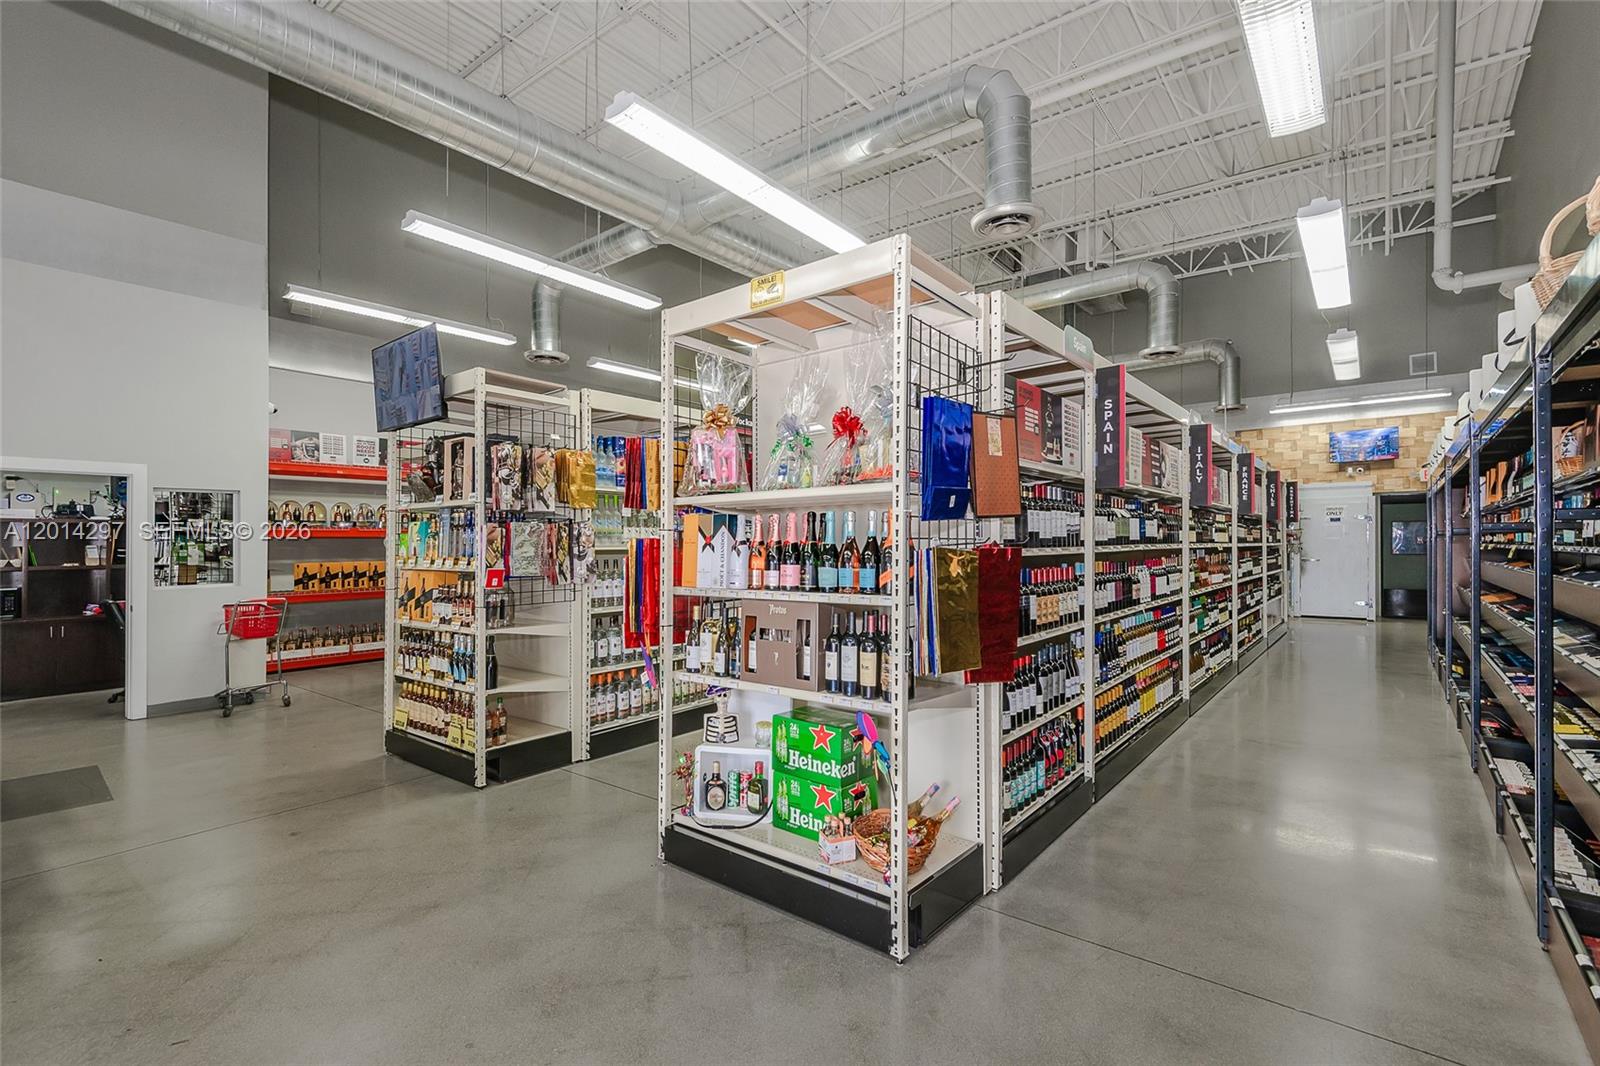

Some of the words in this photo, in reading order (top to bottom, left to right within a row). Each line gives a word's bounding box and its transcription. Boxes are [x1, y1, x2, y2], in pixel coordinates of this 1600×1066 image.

[757, 274, 777, 287] SMILE!
[1103, 399, 1114, 454] SPAIN
[1195, 446, 1204, 483] ITALY
[1241, 466, 1249, 501] FRANCE
[768, 603, 787, 615] Protos
[788, 749, 856, 778] Heineken
